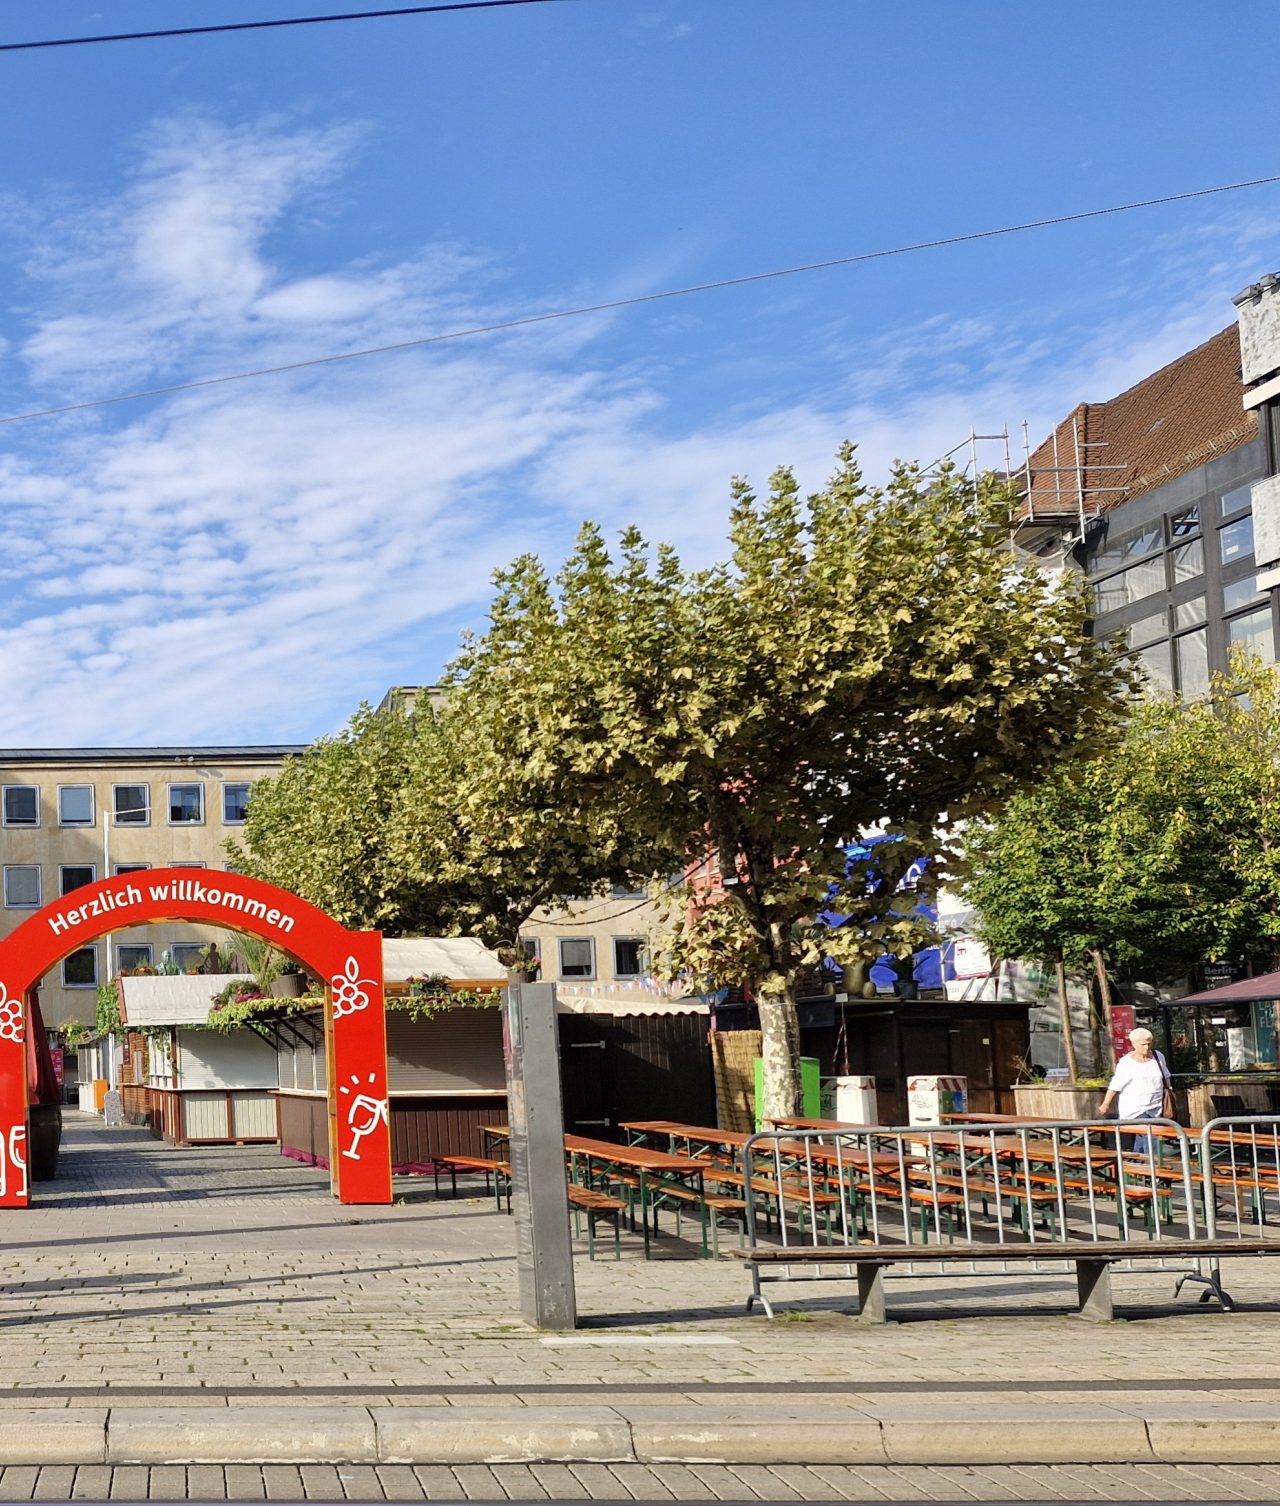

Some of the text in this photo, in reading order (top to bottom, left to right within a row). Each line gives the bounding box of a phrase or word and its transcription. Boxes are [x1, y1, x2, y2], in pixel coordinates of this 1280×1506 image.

[47, 879, 295, 936] Herzlich willkommen
[1204, 965, 1238, 975] Berlitz
